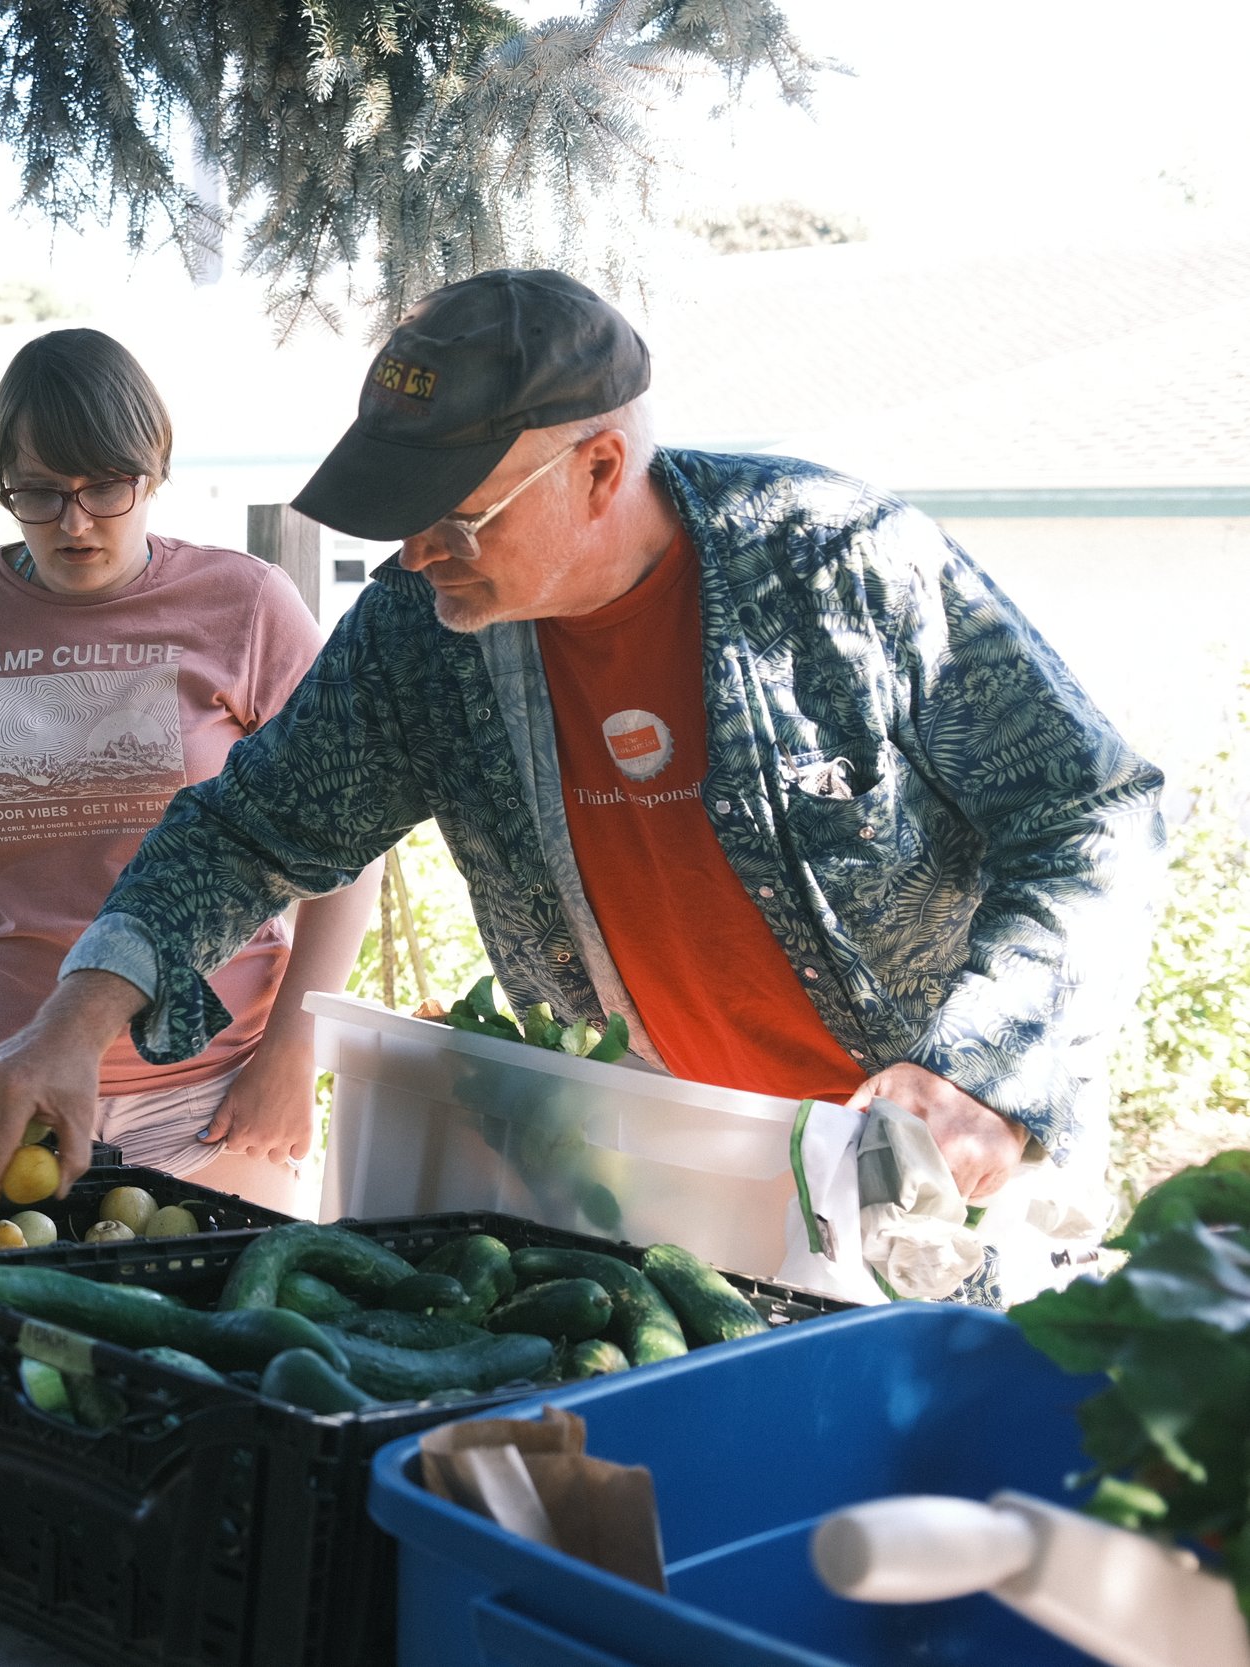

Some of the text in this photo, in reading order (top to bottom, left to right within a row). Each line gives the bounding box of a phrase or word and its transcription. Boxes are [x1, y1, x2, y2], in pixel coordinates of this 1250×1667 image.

[52, 643, 184, 667] CULTURE
[573, 787, 626, 805] Think
[27, 806, 69, 819] VIBES
[82, 803, 109, 815] GET
[114, 802, 128, 812] IN
